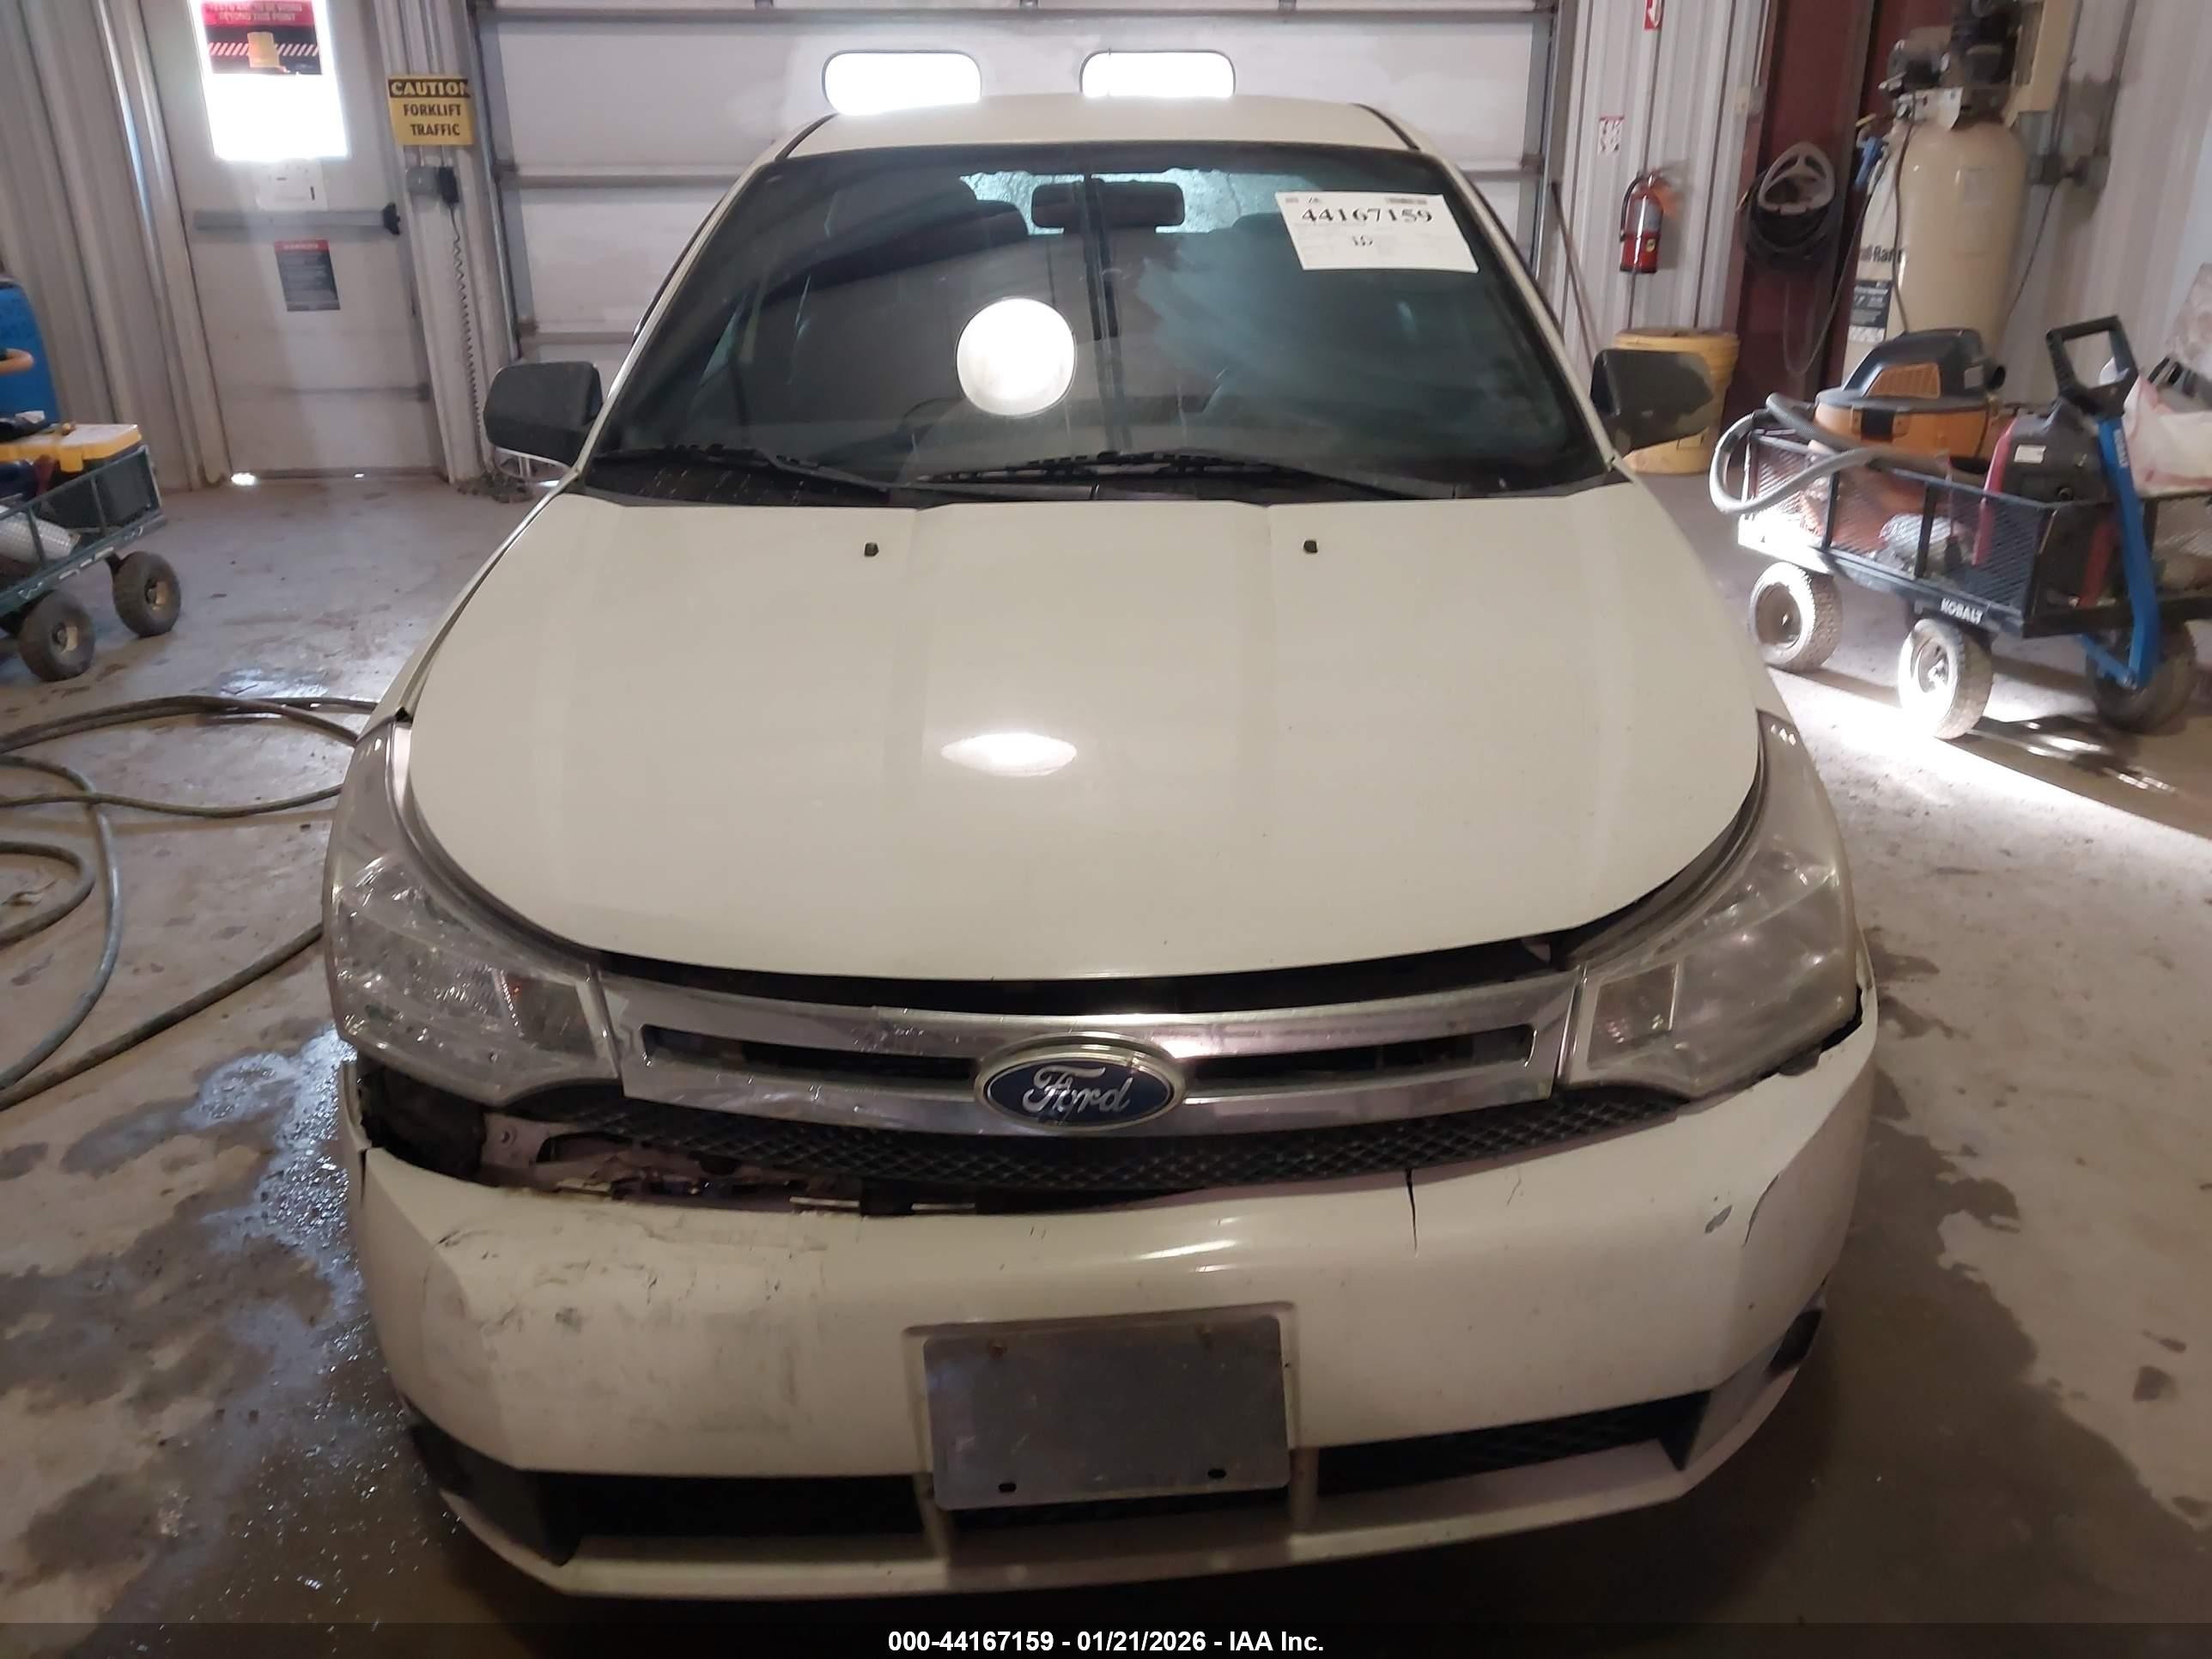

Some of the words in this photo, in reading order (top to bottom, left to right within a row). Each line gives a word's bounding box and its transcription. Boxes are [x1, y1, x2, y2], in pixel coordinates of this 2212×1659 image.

[391, 82, 470, 96] CAUTION
[404, 104, 461, 116] FORKLIFT
[410, 124, 461, 137] TRAFFIC
[1301, 208, 1433, 222] 44167159
[1941, 598, 1984, 625] KOBALT
[1023, 1065, 1133, 1114] Ford
